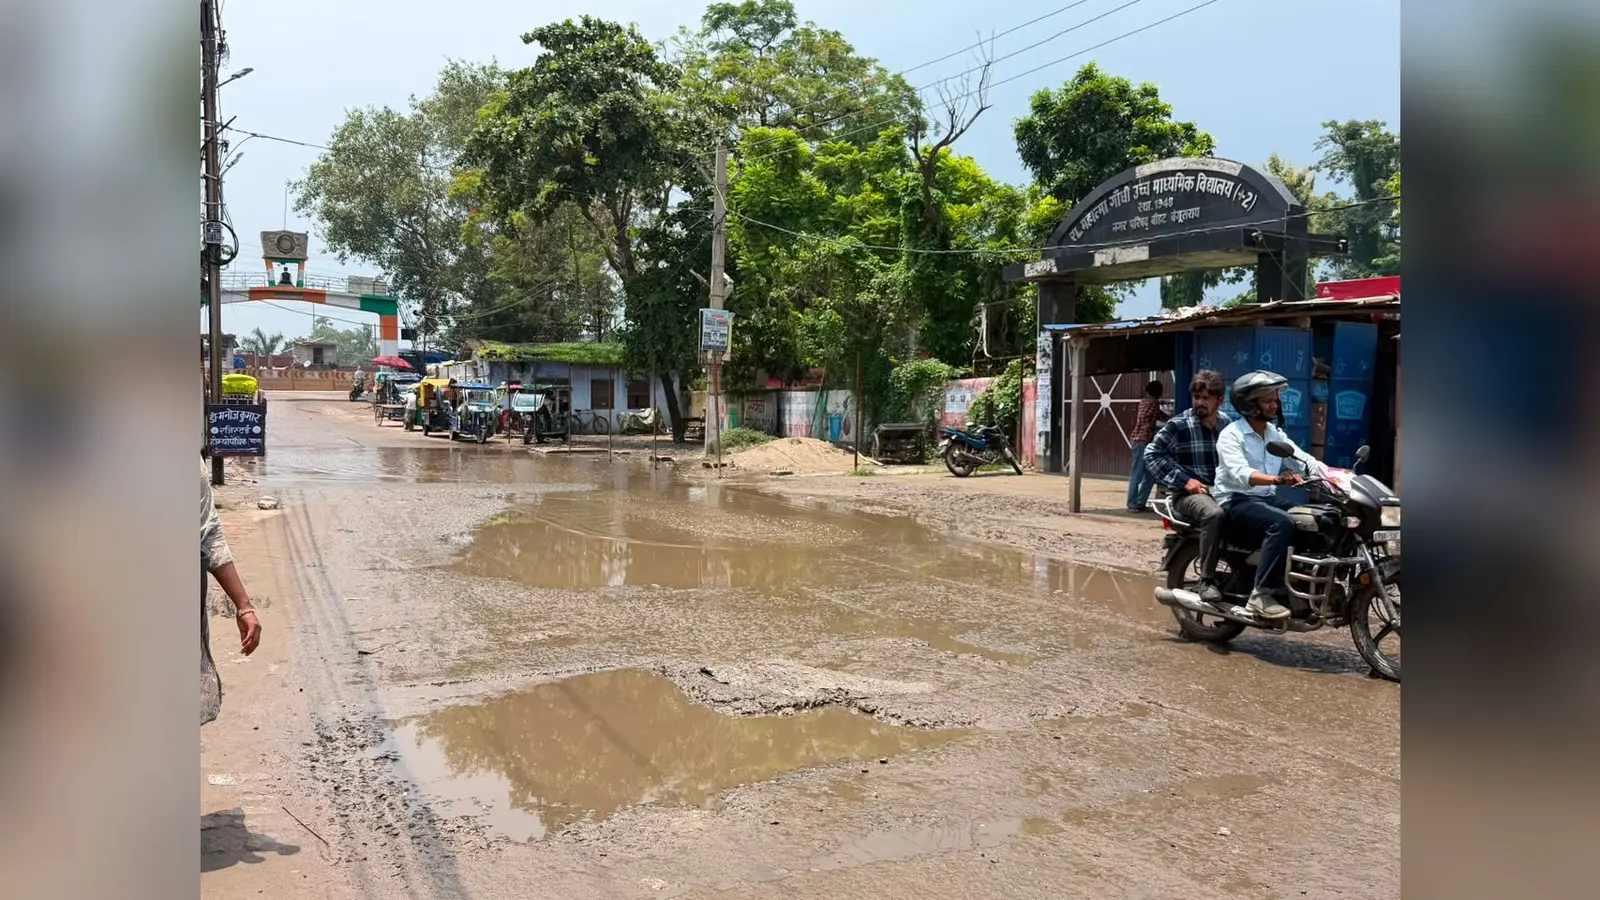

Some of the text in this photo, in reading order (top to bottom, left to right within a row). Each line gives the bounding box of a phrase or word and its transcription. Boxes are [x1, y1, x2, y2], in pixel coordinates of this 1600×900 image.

[1080, 199, 1109, 231] महात्मा
[1132, 181, 1150, 200] उच्च
[1153, 172, 1196, 195] माध्यमिक
[1196, 172, 1235, 198] विद्यालय
[1232, 184, 1258, 212] (+2)
[1155, 196, 1174, 210] 1948
[1112, 220, 1127, 233] नगर
[218, 407, 239, 420] मनोज
[239, 410, 262, 424] कुमार
